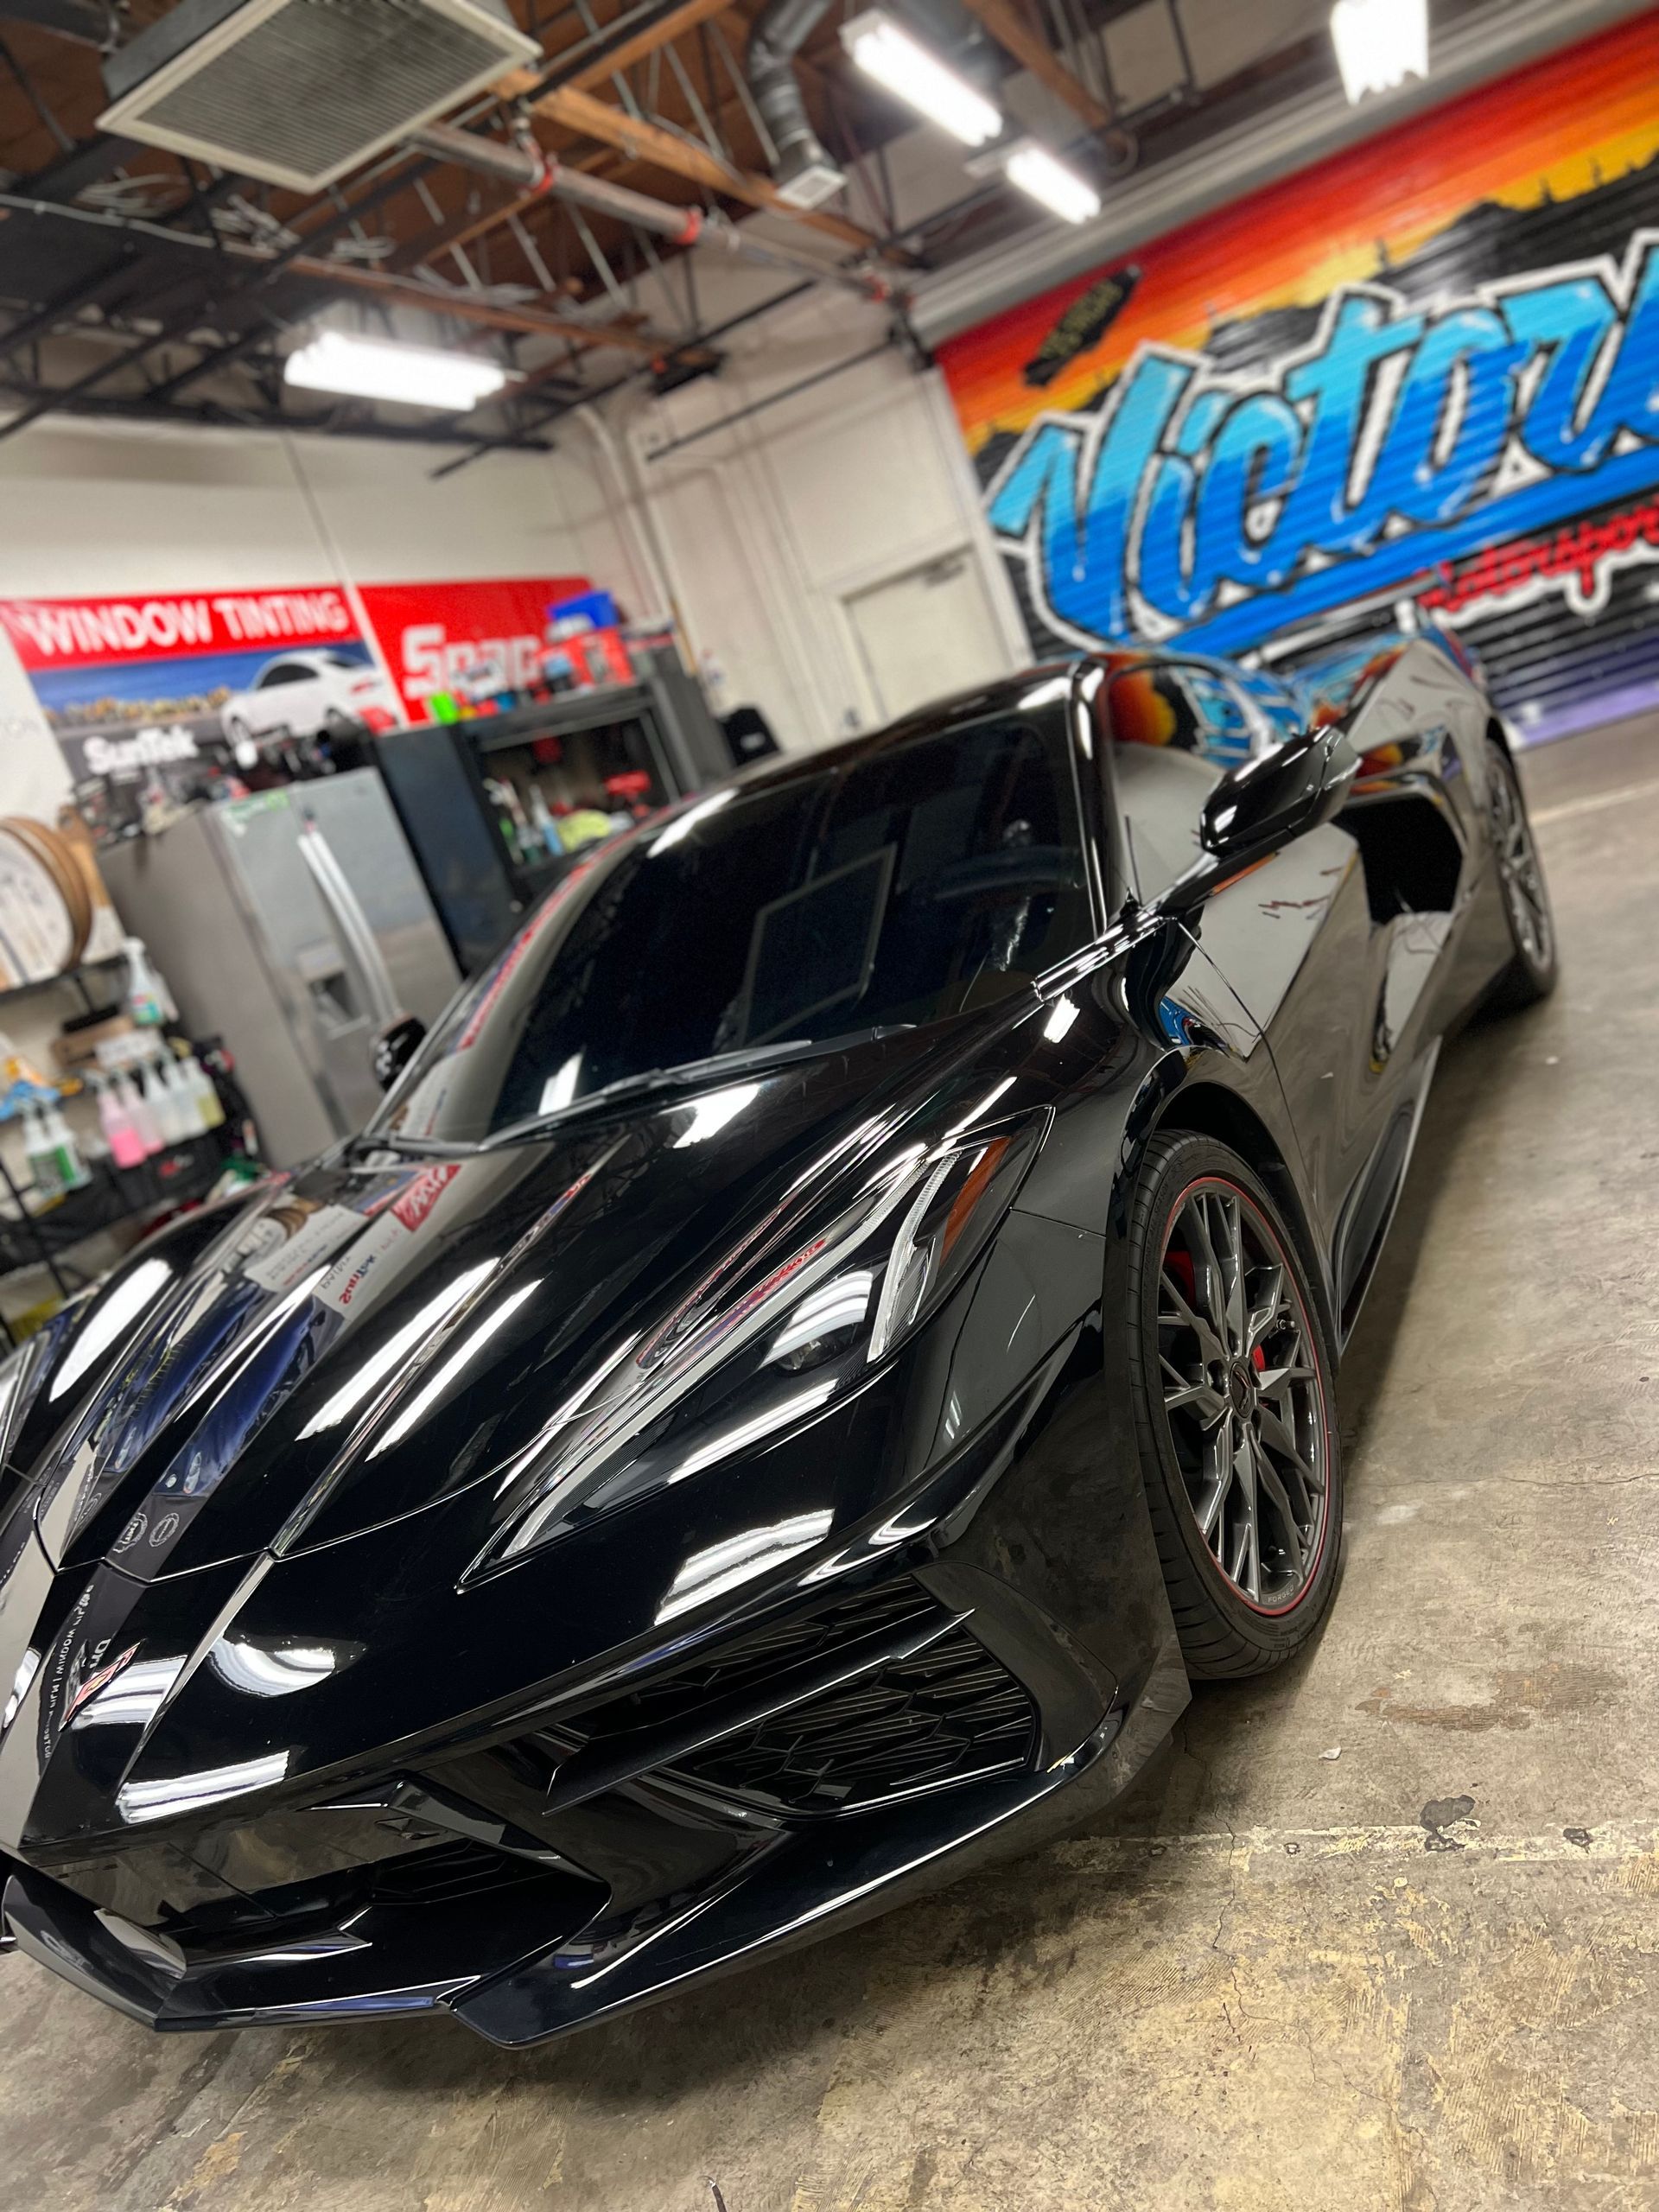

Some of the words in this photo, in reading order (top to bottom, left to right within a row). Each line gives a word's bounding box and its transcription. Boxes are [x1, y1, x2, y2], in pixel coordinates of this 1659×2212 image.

[22, 601, 213, 657] WINDOW
[214, 592, 348, 641] TINTING
[1267, 1583, 1295, 1604] FORGED
